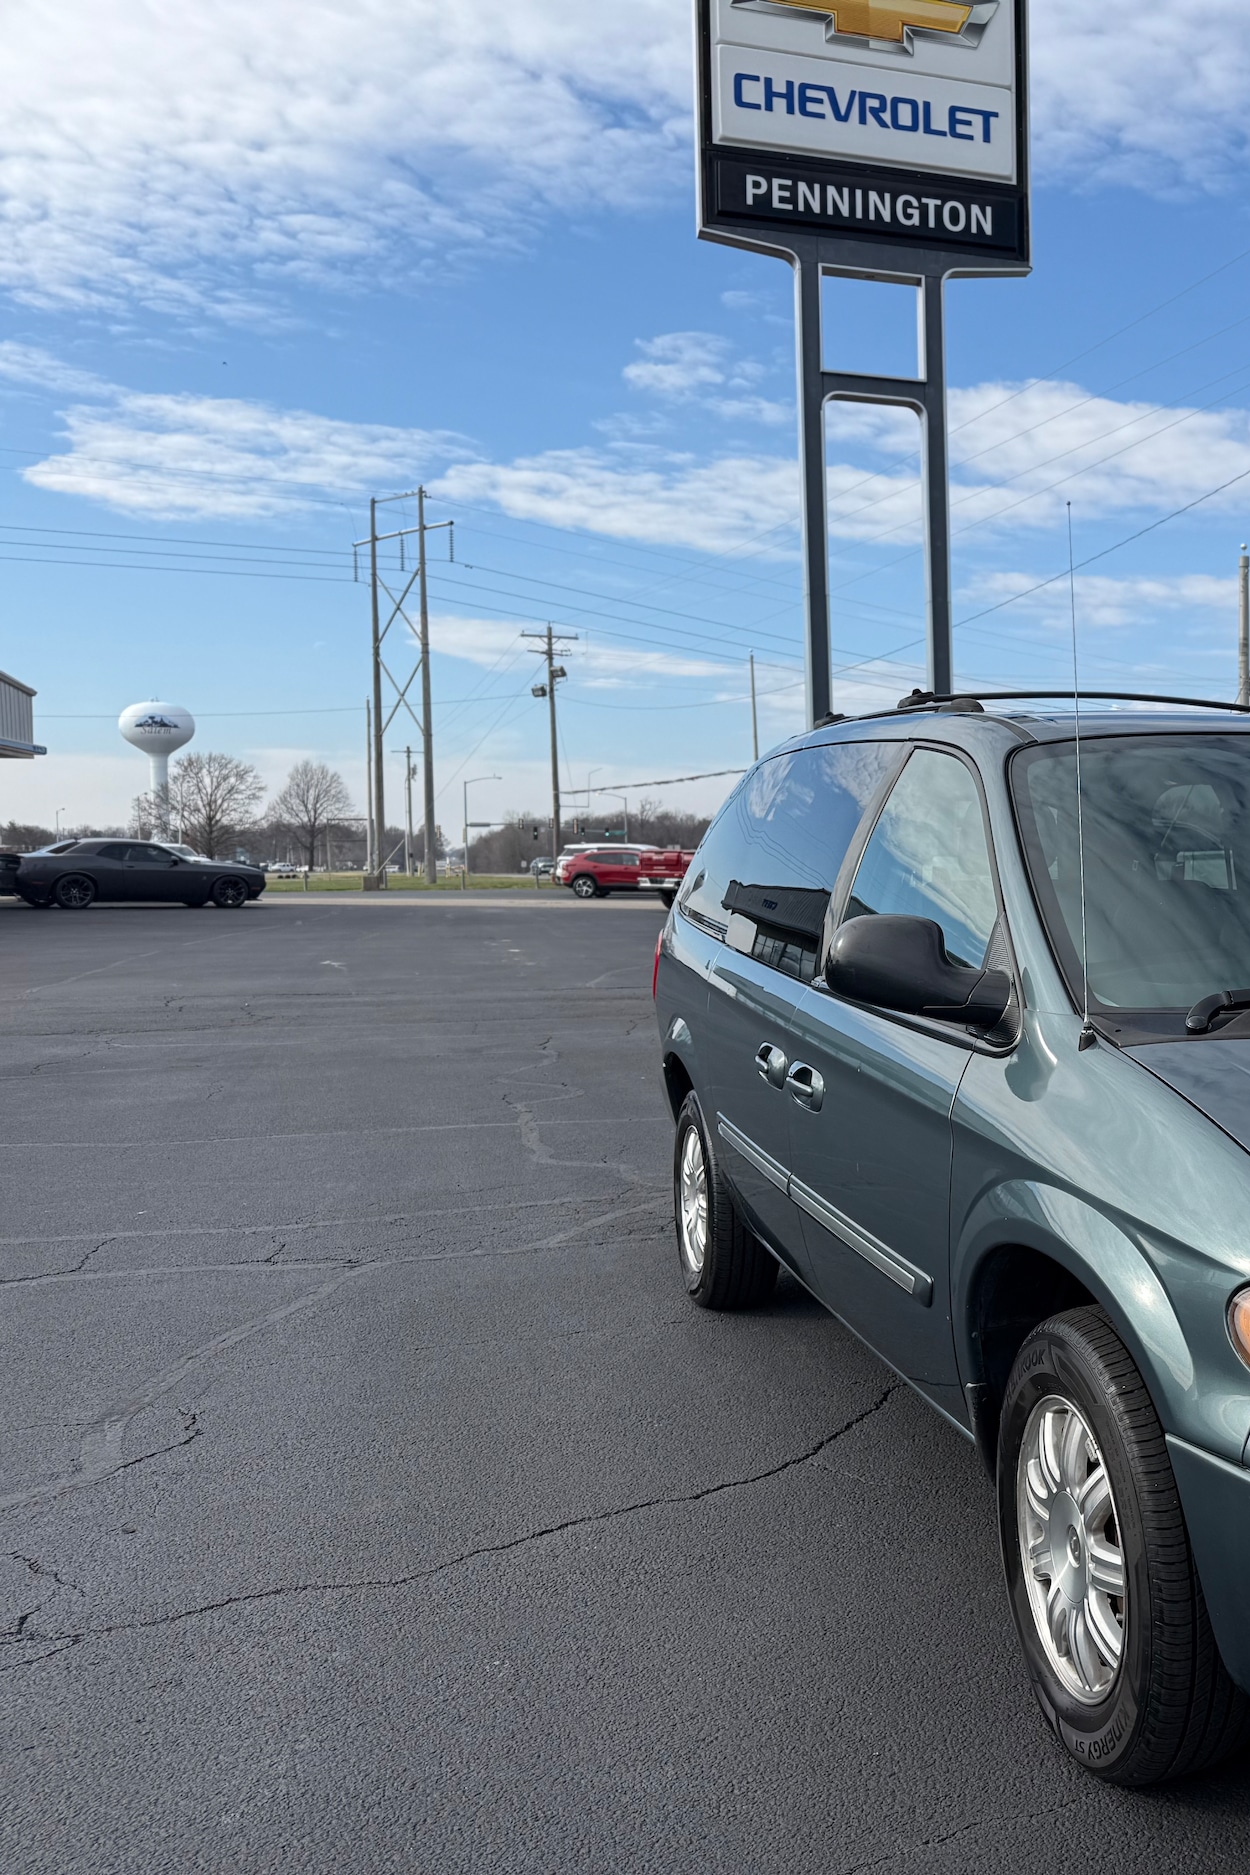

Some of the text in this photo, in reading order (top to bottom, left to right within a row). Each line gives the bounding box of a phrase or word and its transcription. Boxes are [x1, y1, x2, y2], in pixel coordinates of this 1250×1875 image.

[733, 72, 1000, 144] CHEVROLET
[745, 174, 994, 236] PENNINGTON
[1088, 1701, 1131, 1760] KINERGY
